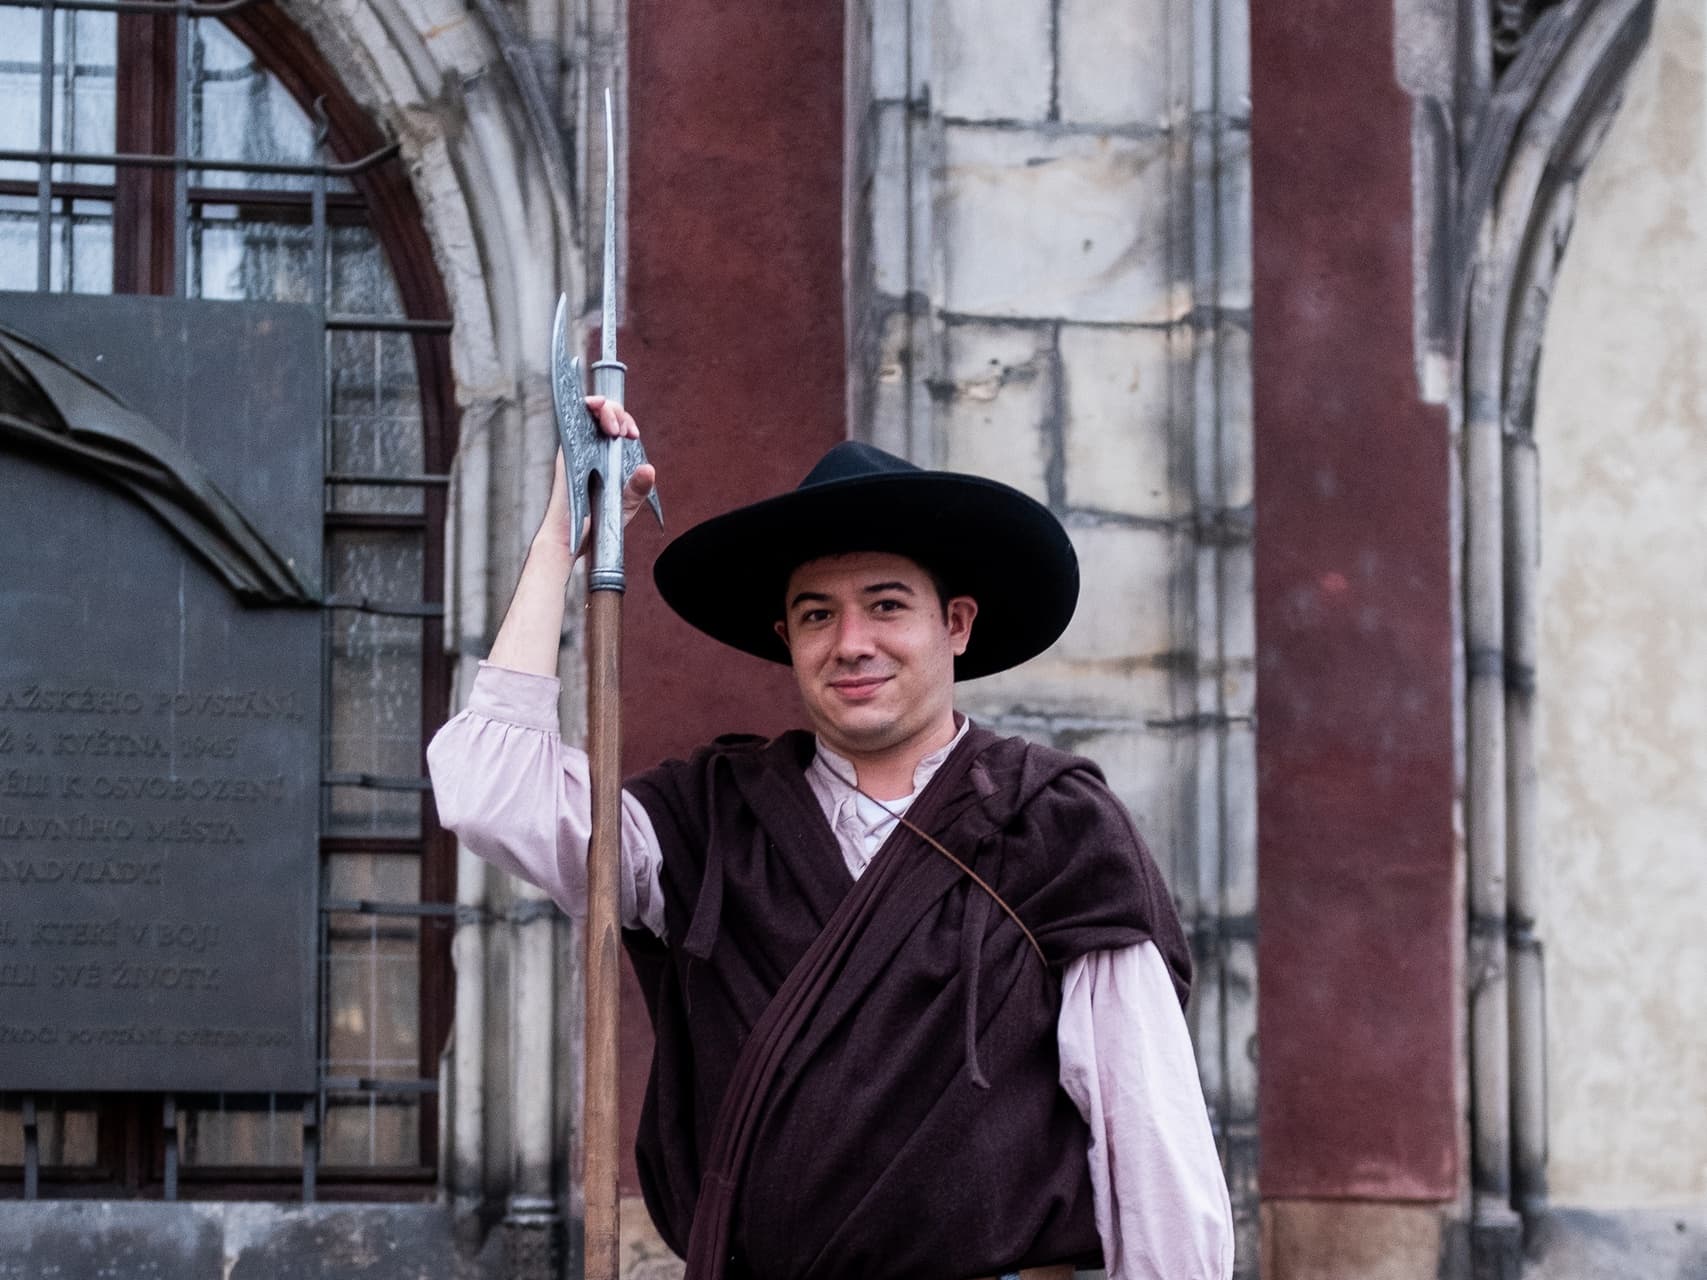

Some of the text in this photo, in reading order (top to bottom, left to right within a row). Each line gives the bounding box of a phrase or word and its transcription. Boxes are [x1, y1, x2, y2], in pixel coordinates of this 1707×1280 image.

[181, 735, 239, 759] 1945
[0, 769, 49, 799] ĚLI
[61, 776, 85, 799] K
[146, 814, 245, 844] MĚSTA
[127, 922, 149, 945] V
